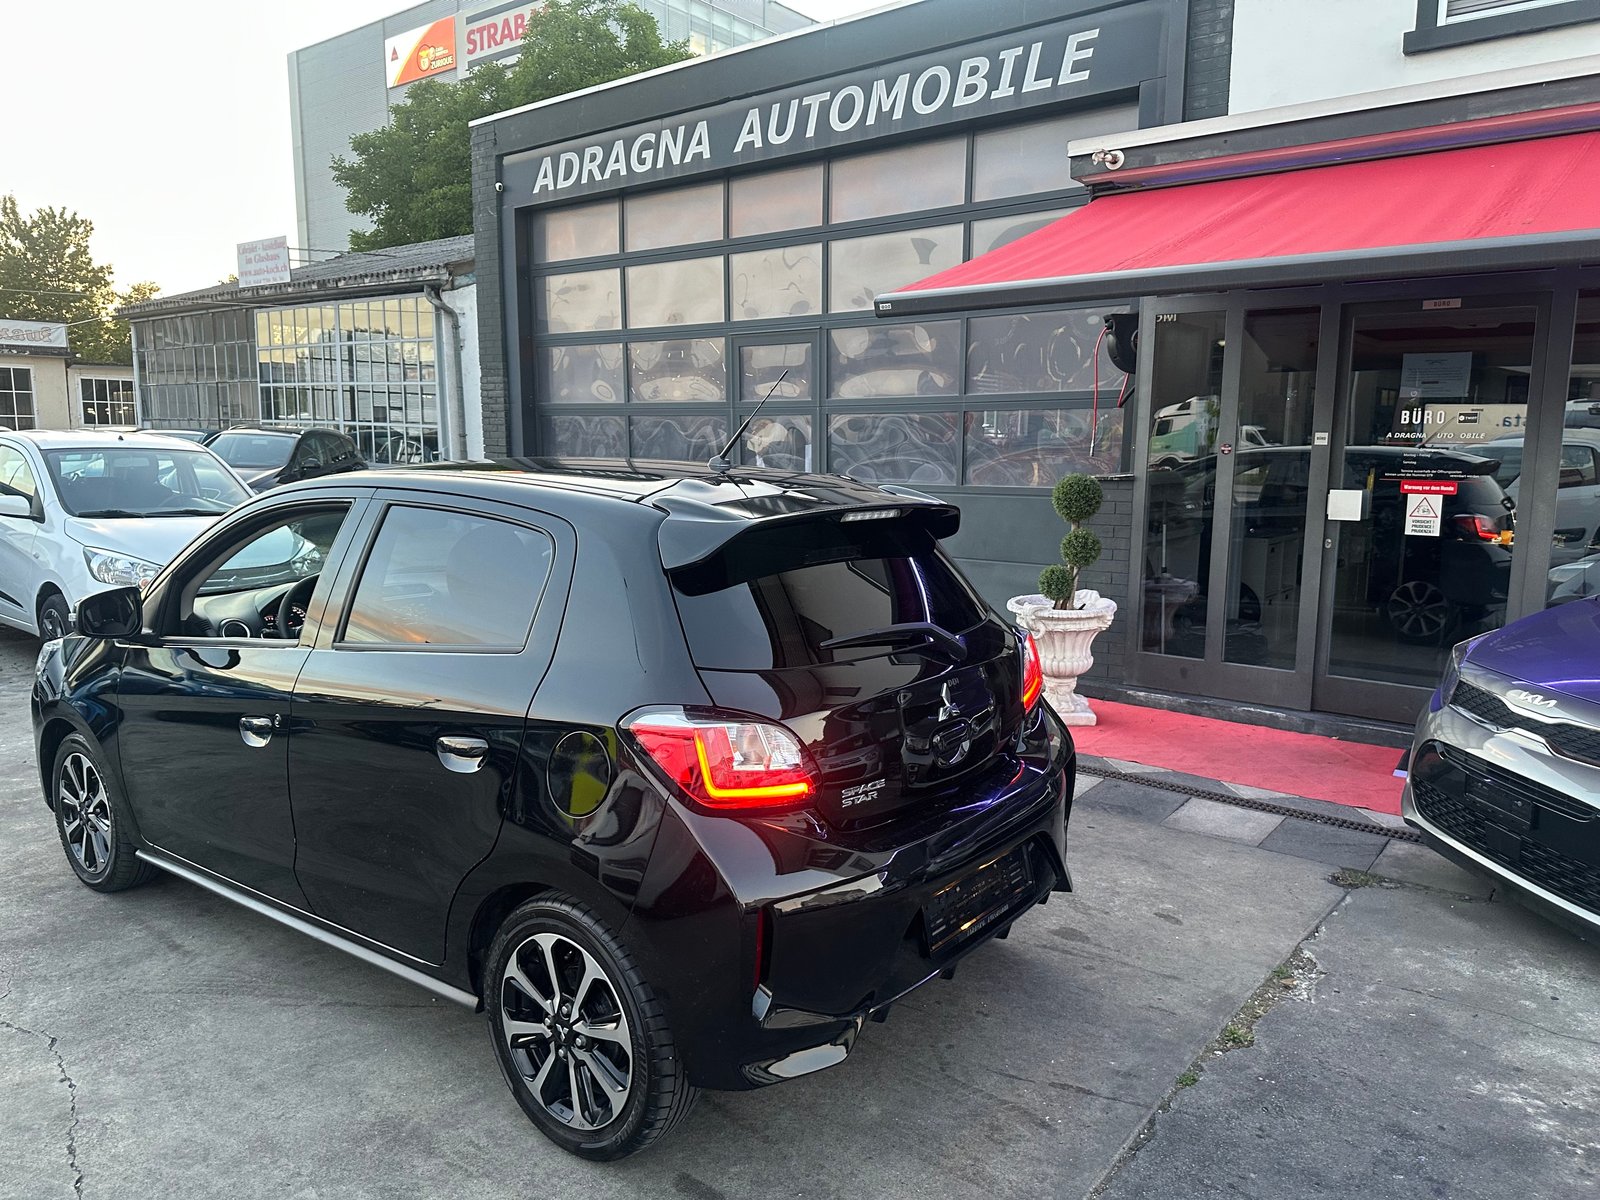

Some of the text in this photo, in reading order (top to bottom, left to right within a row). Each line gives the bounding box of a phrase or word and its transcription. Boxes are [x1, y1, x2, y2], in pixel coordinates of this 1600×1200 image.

[466, 5, 548, 55] STRAB
[532, 28, 1100, 194] ADRAGNA AUTOMOBILE
[1400, 408, 1445, 424] BÜRO
[842, 779, 886, 798] SPACE
[842, 791, 878, 808] STAR
